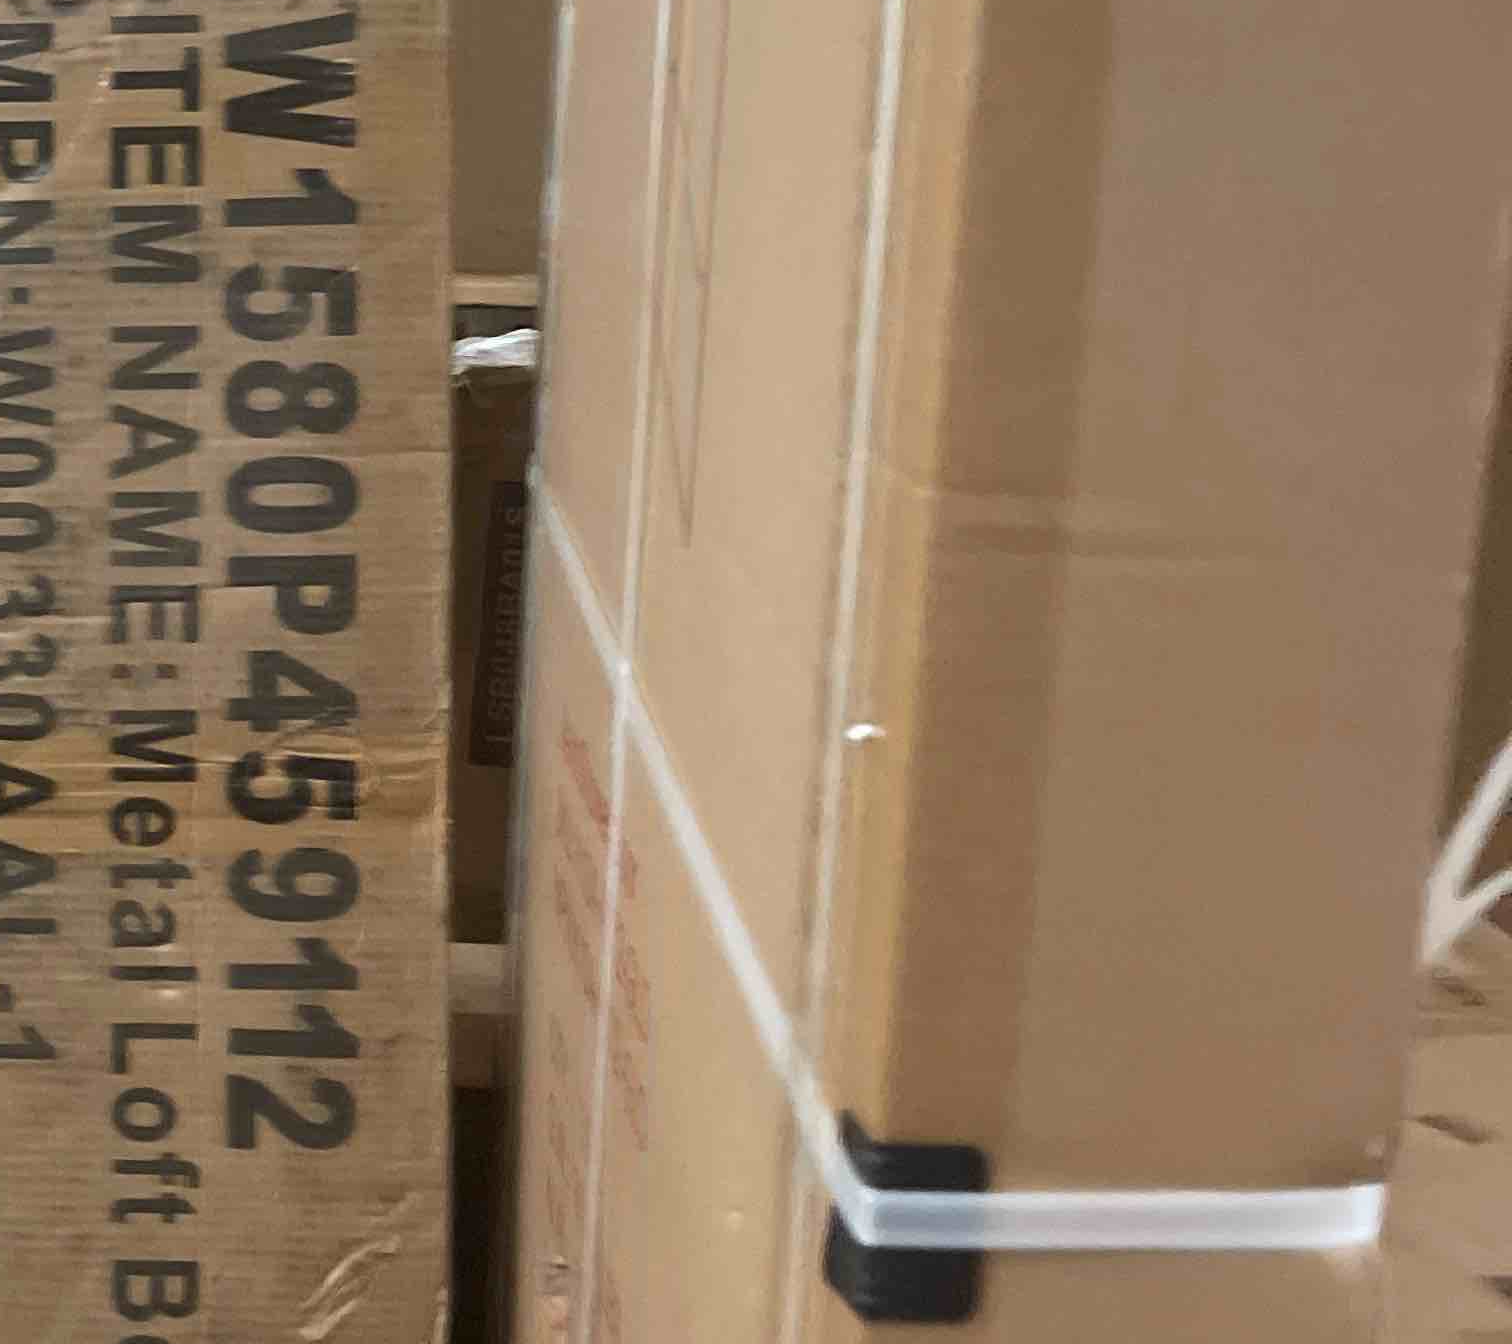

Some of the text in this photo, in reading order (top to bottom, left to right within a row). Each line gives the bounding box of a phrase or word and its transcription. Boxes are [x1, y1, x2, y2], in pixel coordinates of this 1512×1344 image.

[109, 15, 201, 284] ITEM
[224, 13, 359, 1151] W1580P459112
[109, 708, 201, 983] Metal
[110, 1022, 201, 1223] Loft
